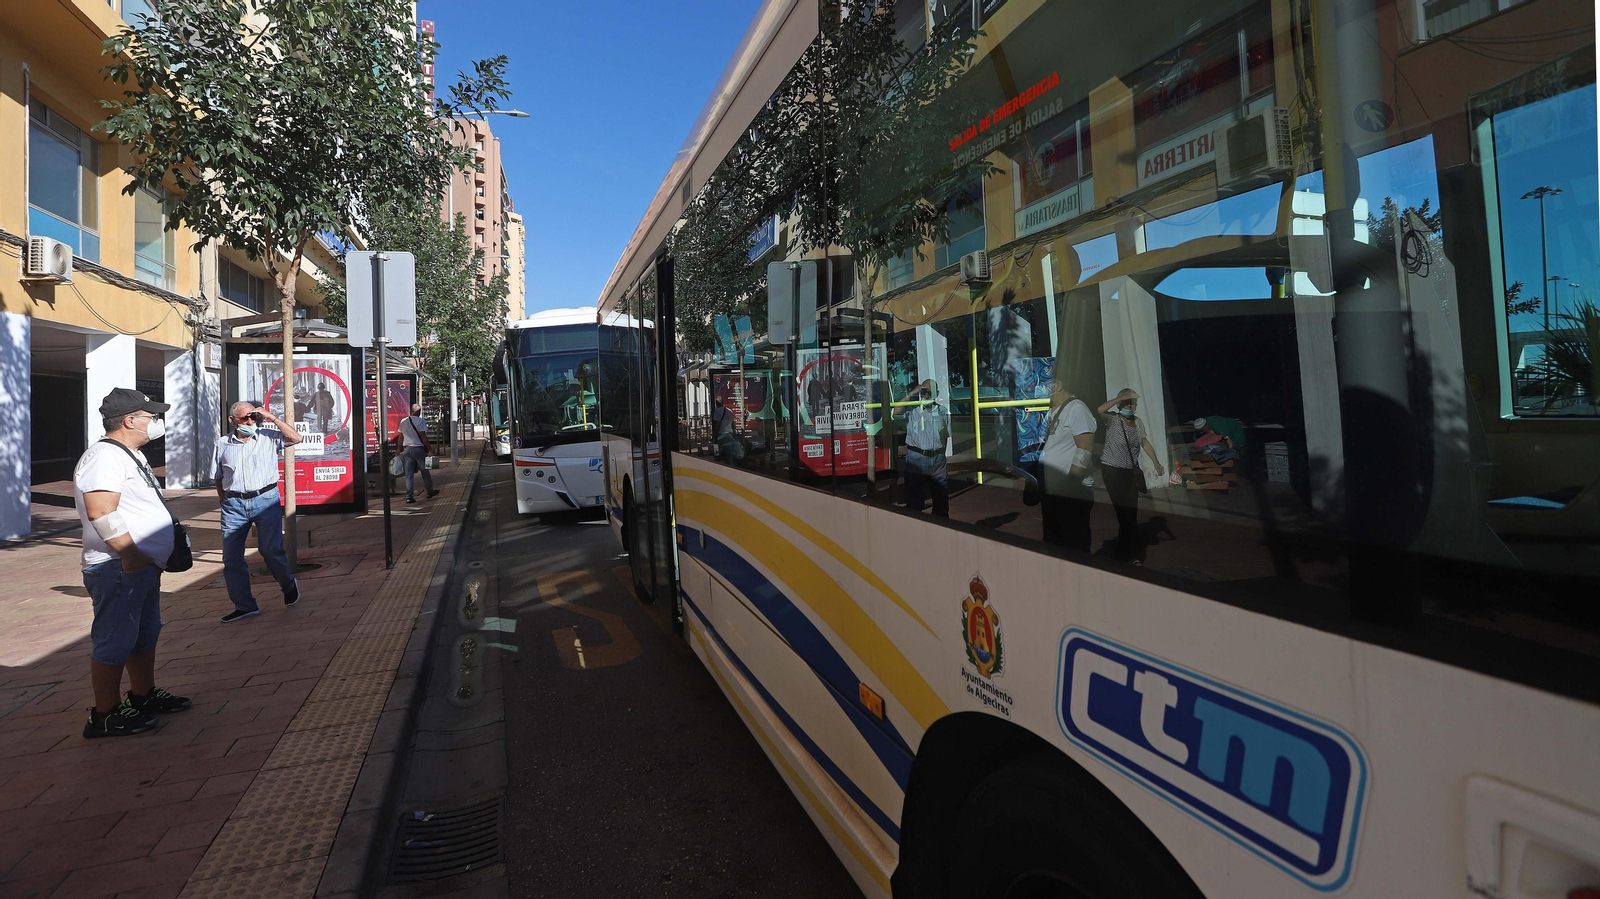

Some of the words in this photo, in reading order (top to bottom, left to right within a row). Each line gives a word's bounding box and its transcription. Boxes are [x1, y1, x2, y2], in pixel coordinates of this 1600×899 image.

[949, 124, 978, 152] SALIDA
[979, 114, 991, 133] DE
[992, 70, 1060, 124] EMERGENCIA
[961, 666, 1013, 706] Ayuntamiento
[966, 683, 974, 695] de
[975, 687, 1010, 717] Algeciras
[1070, 648, 1331, 860] ctm
